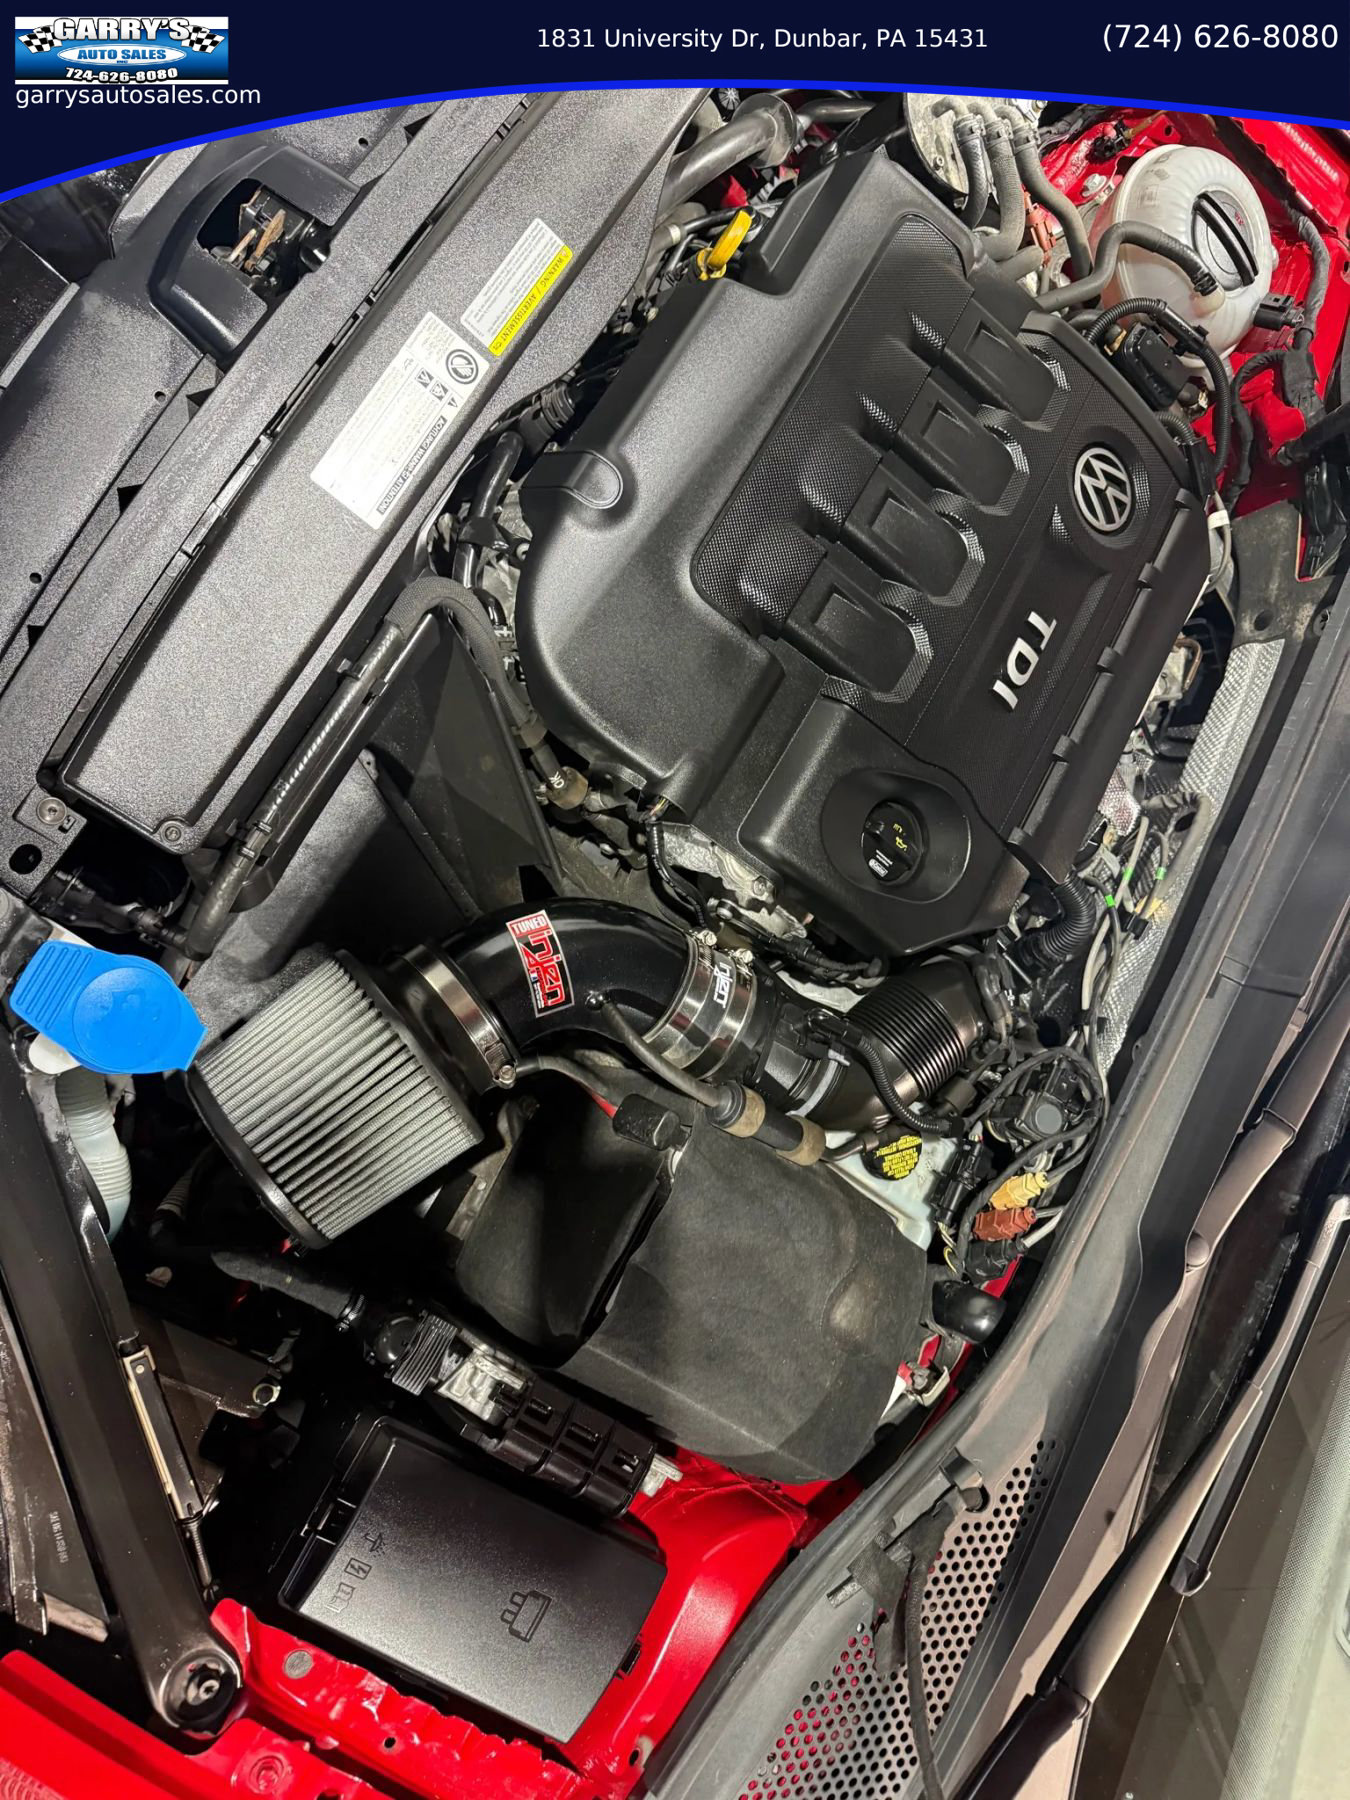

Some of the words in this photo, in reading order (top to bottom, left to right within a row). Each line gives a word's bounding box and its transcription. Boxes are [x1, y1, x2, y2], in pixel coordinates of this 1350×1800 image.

[537, 254, 564, 288] WARNING
[992, 611, 1057, 710] TDI
[511, 913, 547, 935] TUNED
[520, 926, 567, 1008] injen
